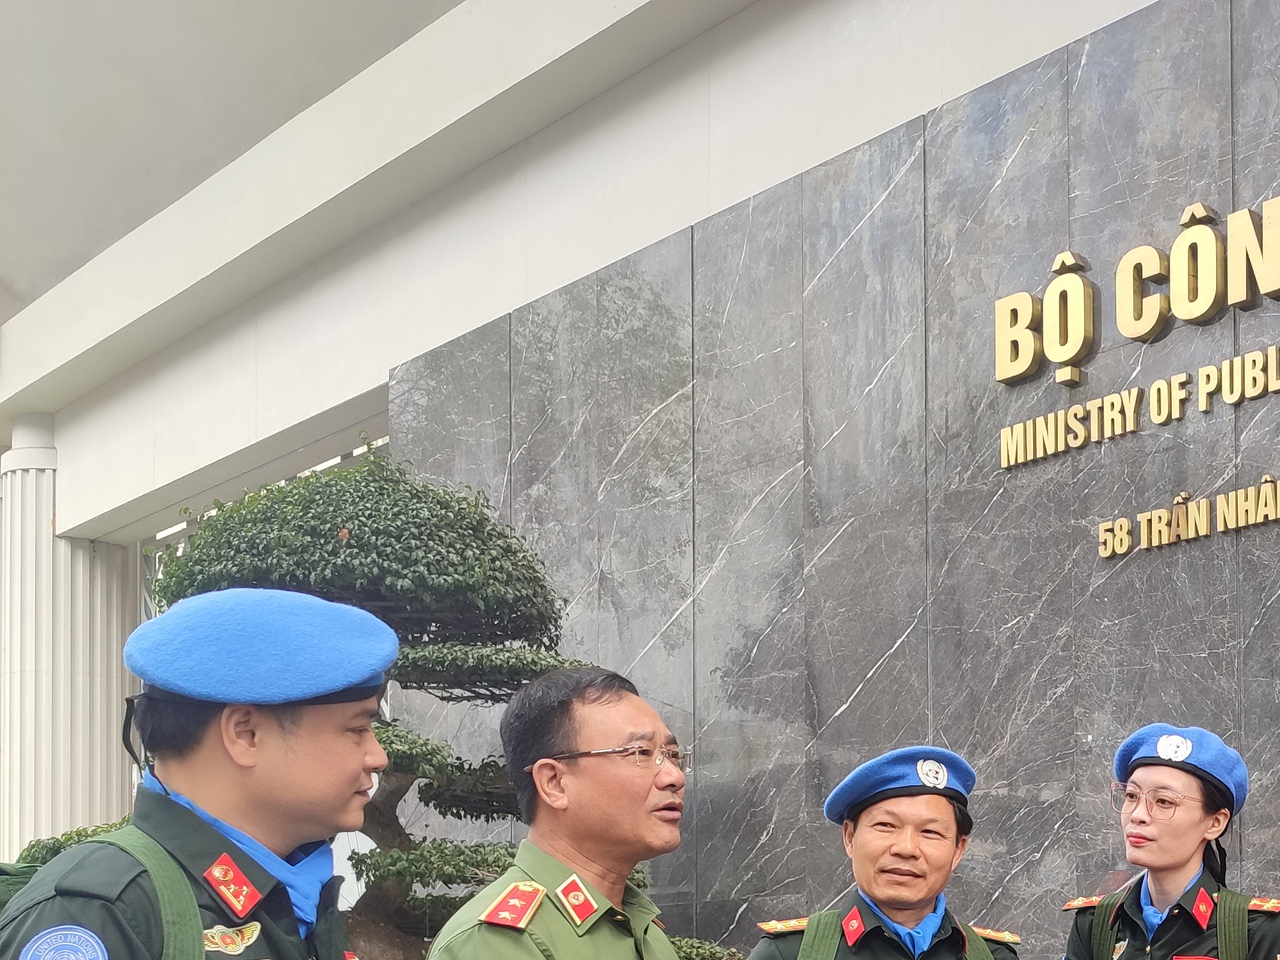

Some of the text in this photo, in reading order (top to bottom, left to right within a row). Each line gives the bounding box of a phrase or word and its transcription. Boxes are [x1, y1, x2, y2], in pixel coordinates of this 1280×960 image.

[995, 250, 1094, 386] BỘ
[1000, 386, 1144, 469] MINISTRY
[1149, 371, 1192, 426] OF
[1098, 518, 1132, 560] 58
[1136, 491, 1211, 551] TRẦN
[35, 934, 97, 959] UNITED NATIONS
